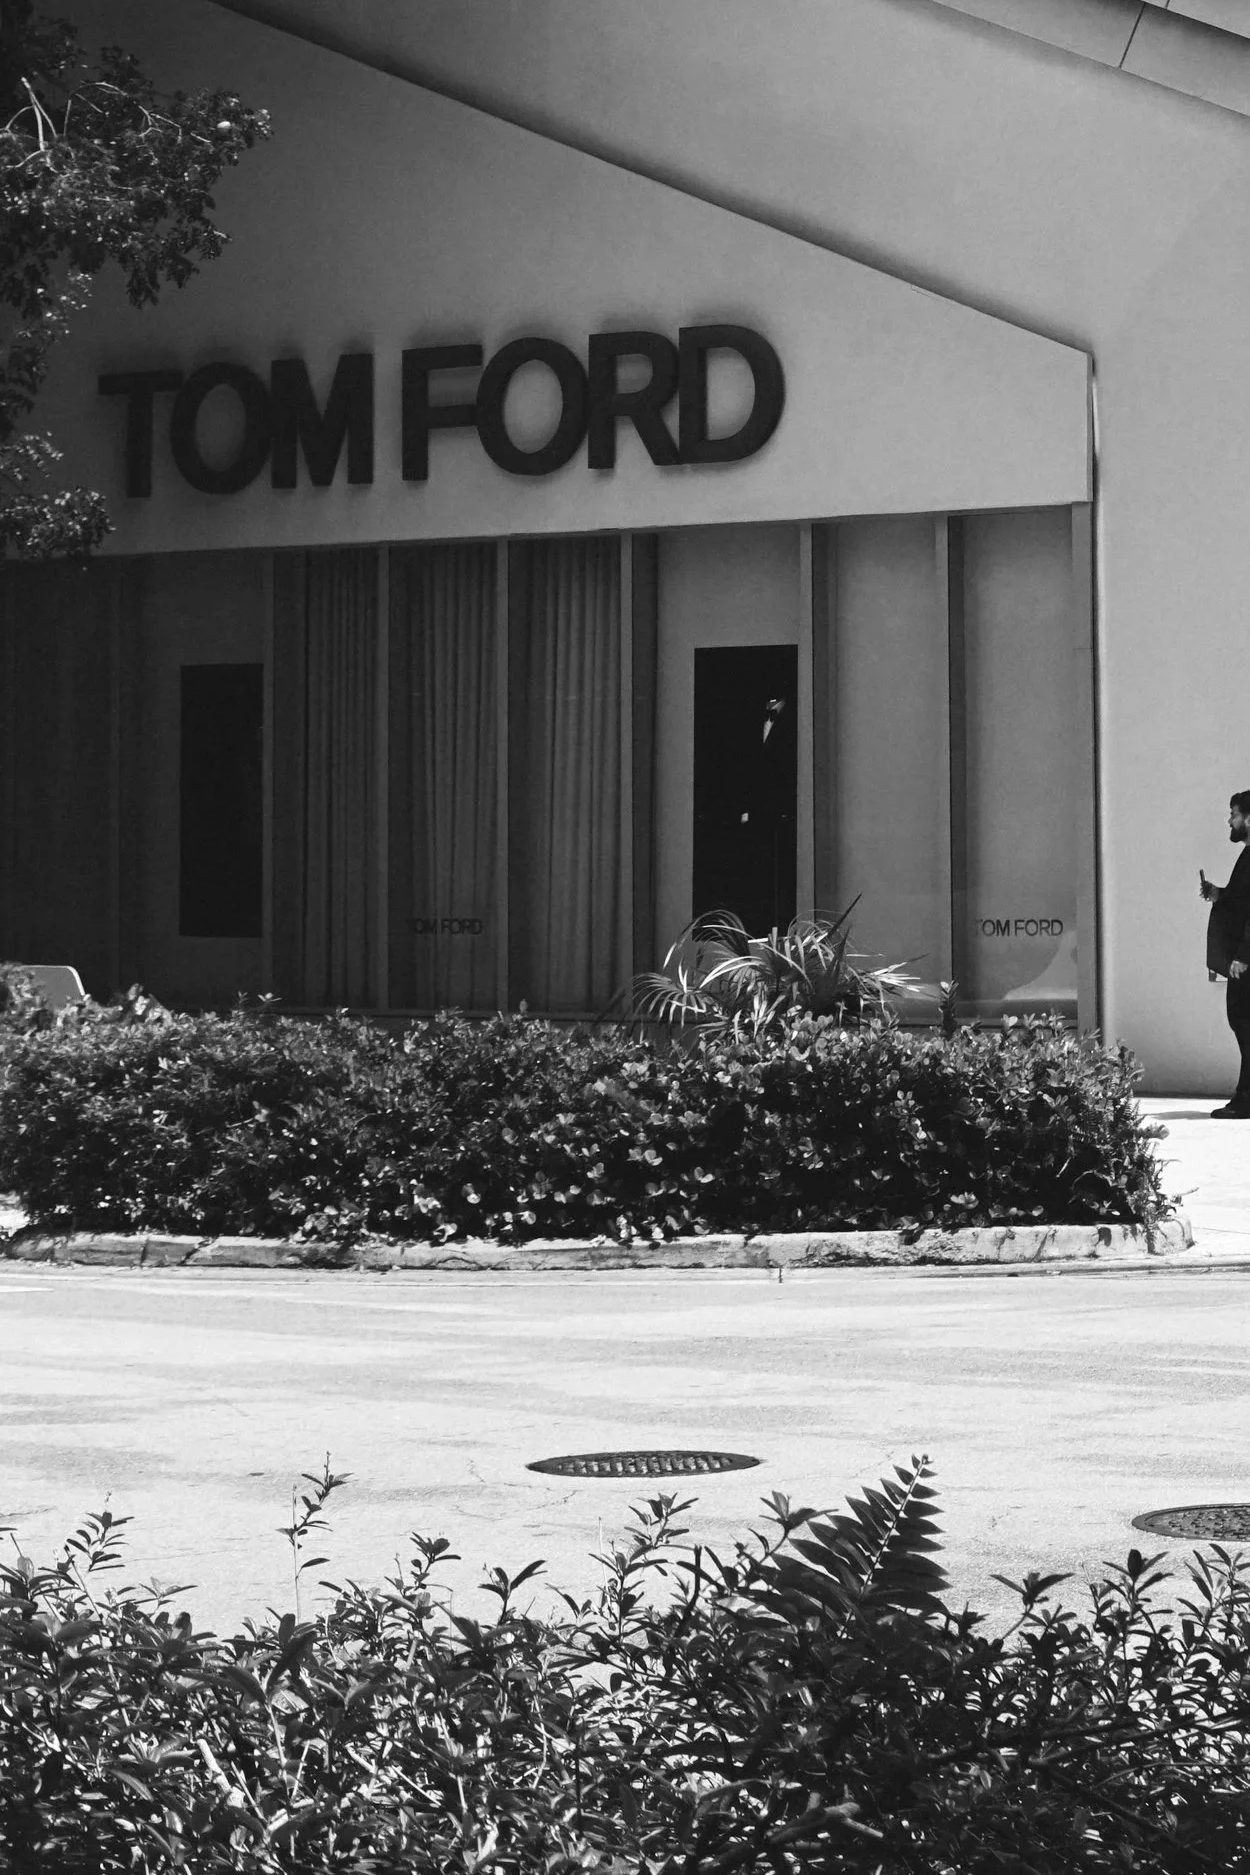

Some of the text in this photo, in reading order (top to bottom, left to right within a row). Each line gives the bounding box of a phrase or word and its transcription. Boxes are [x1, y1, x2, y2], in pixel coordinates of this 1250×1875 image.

[98, 324, 786, 498] TOM FORD
[1014, 919, 1064, 937] FORD
